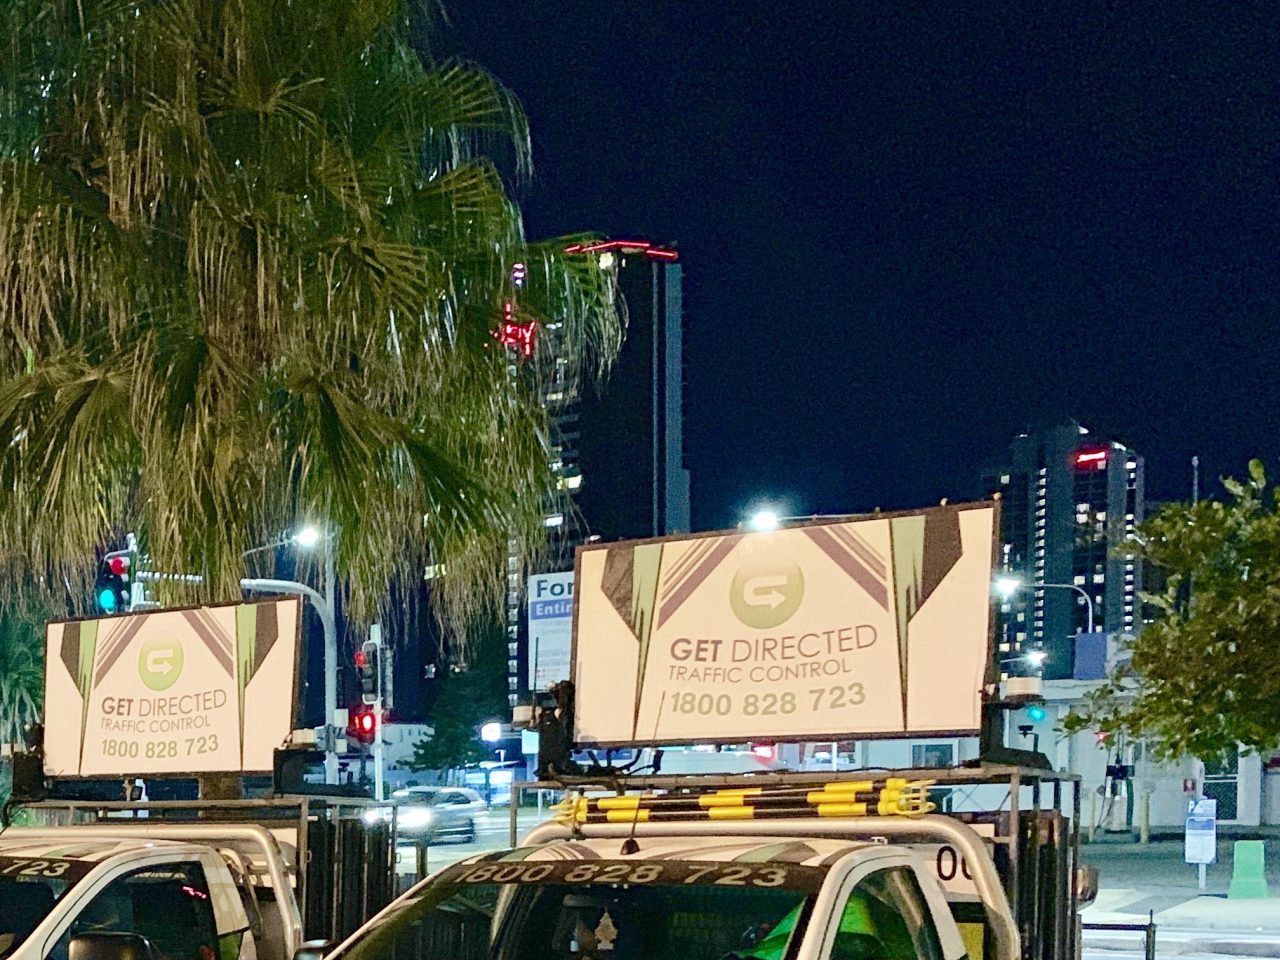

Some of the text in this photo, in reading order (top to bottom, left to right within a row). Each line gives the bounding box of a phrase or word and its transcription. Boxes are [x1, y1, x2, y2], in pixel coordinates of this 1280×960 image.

[670, 624, 878, 663] GET DIRECTED
[669, 658, 851, 683] TRAFFIC CONTROL
[101, 689, 227, 717] GET DIRECTED
[670, 682, 866, 716] 1800 828 723
[100, 715, 211, 733] TRAFFIC CONTROL
[102, 734, 219, 759] 1800 828 723
[1, 860, 70, 877] 723
[455, 864, 787, 887] 1800 828 723
